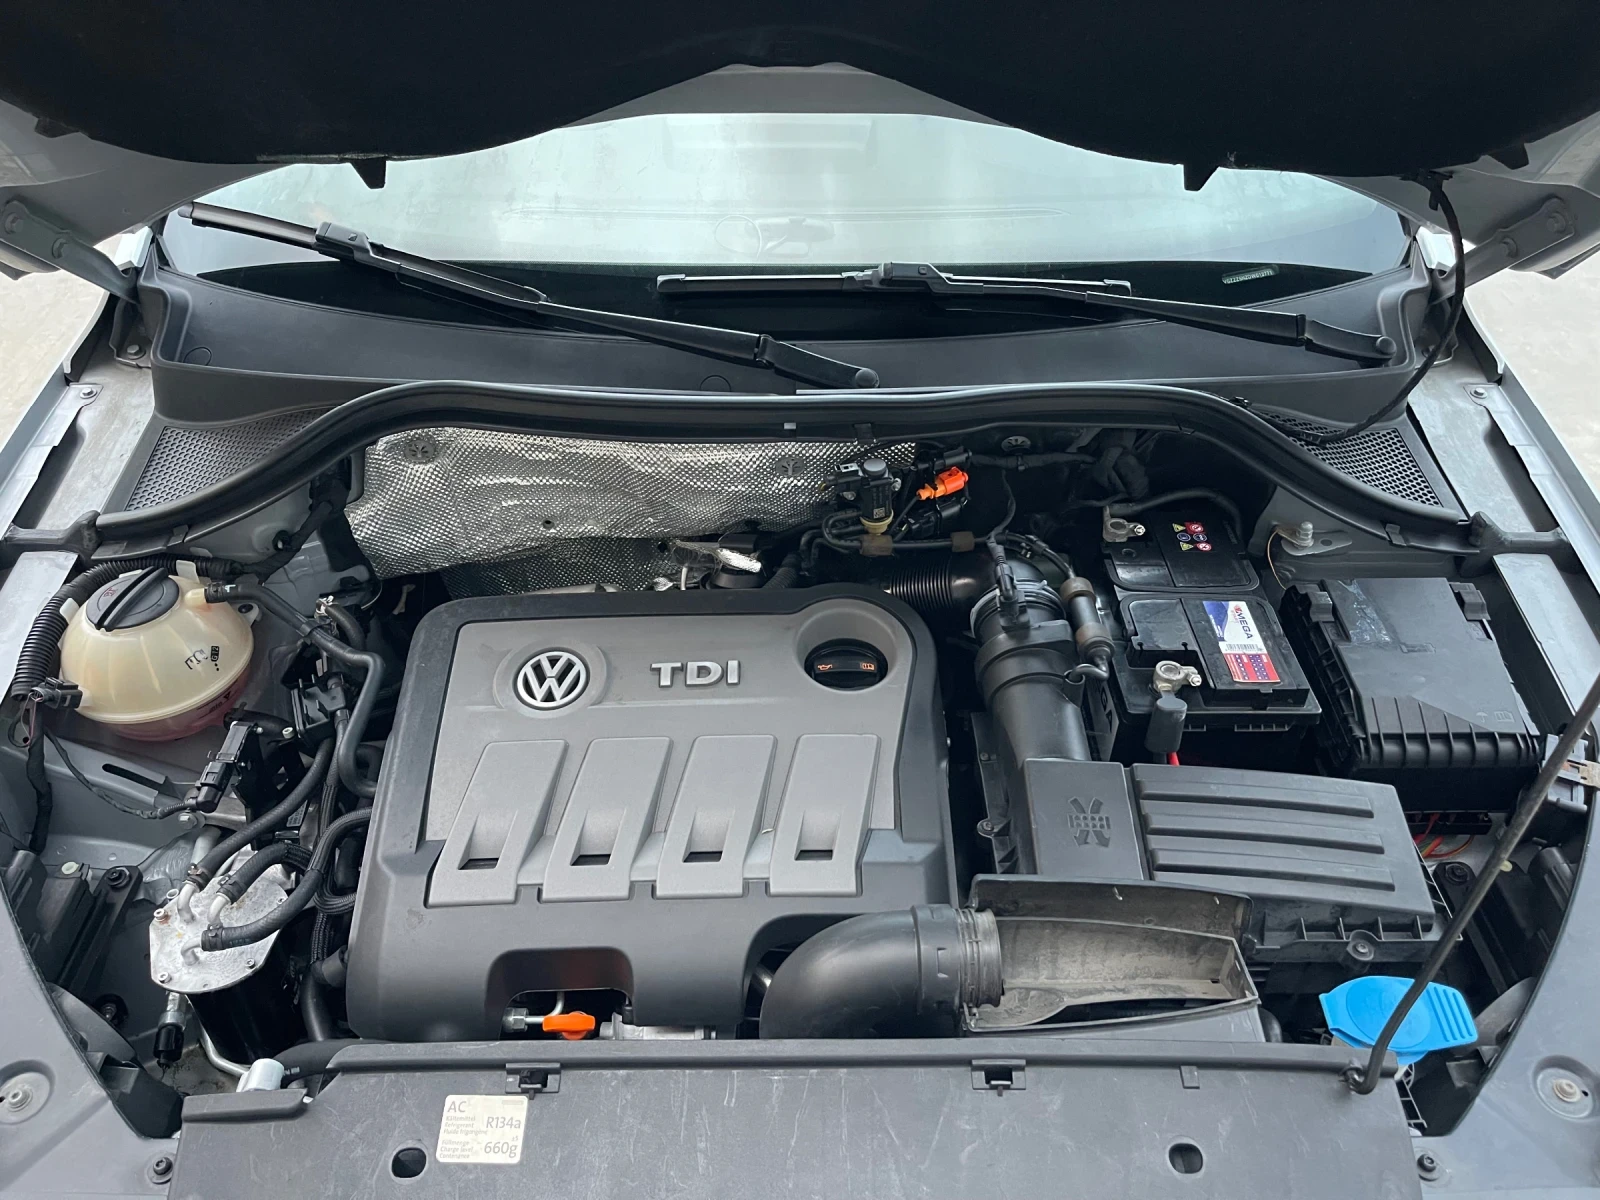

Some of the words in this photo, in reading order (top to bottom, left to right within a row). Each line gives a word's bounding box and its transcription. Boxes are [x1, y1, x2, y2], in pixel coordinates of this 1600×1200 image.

[651, 660, 740, 688] TDI
[447, 1101, 467, 1113] AC
[486, 1116, 522, 1129] R134a
[484, 1141, 518, 1158] 660g
